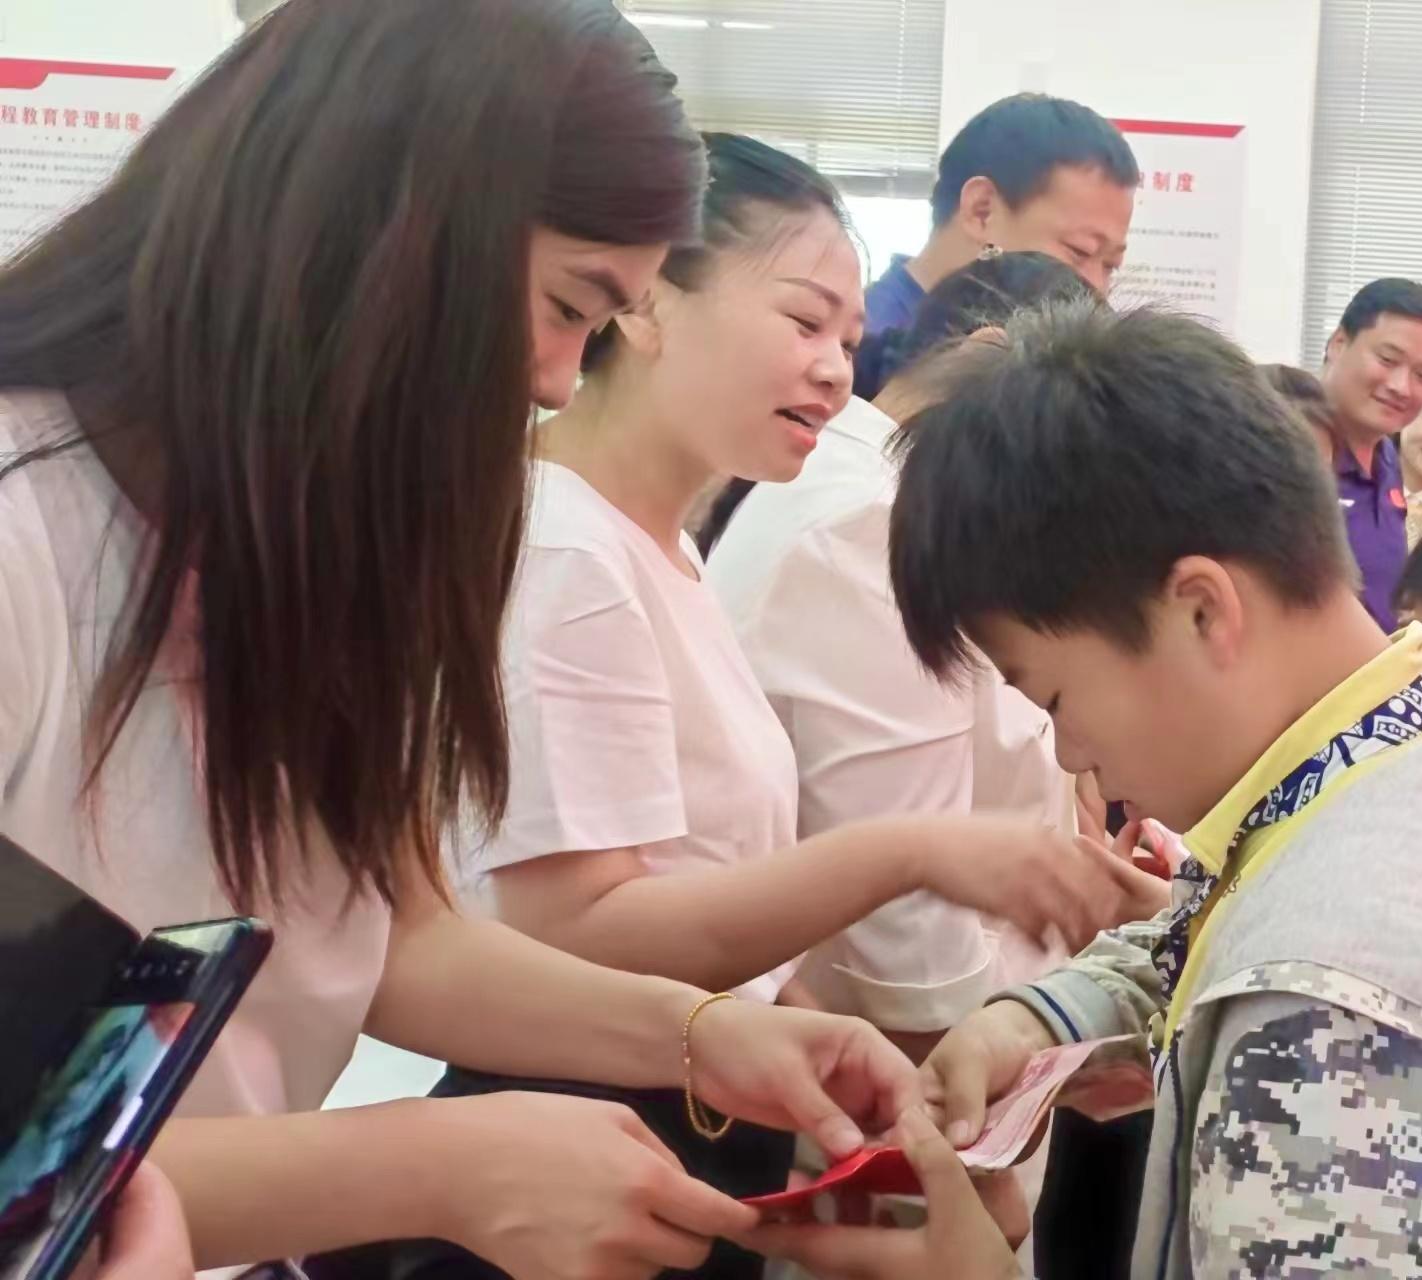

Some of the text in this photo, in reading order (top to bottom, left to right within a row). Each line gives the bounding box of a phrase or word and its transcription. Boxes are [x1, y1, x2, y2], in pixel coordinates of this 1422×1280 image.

[1, 105, 141, 131] 程教育管理制度
